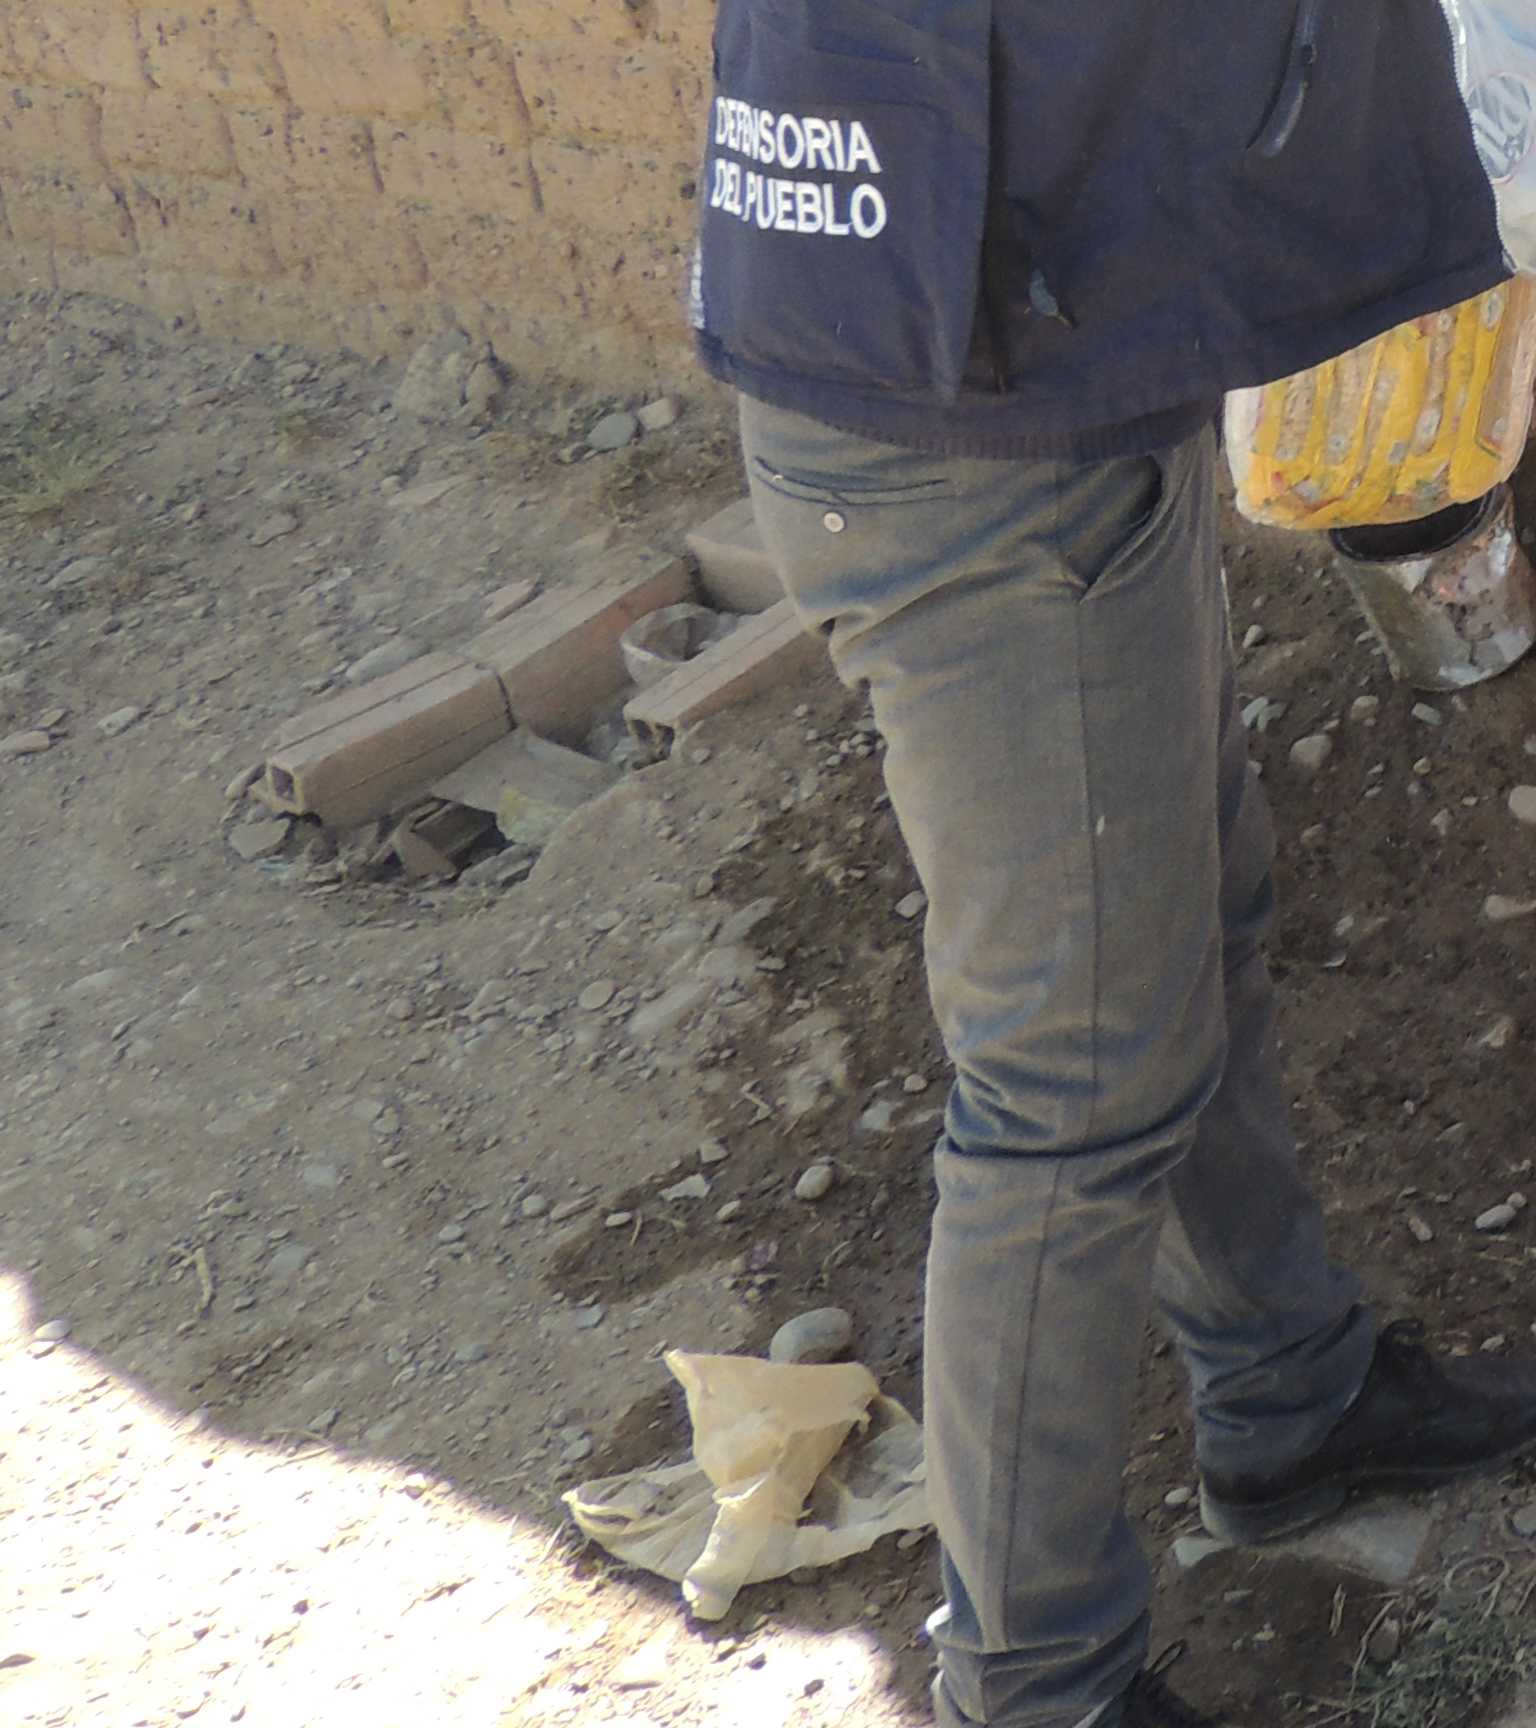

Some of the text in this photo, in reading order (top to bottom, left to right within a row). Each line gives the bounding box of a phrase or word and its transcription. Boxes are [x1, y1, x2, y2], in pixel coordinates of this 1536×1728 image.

[714, 96, 882, 174] DEFENSORIA
[710, 158, 887, 239] DEL PUEBLO
